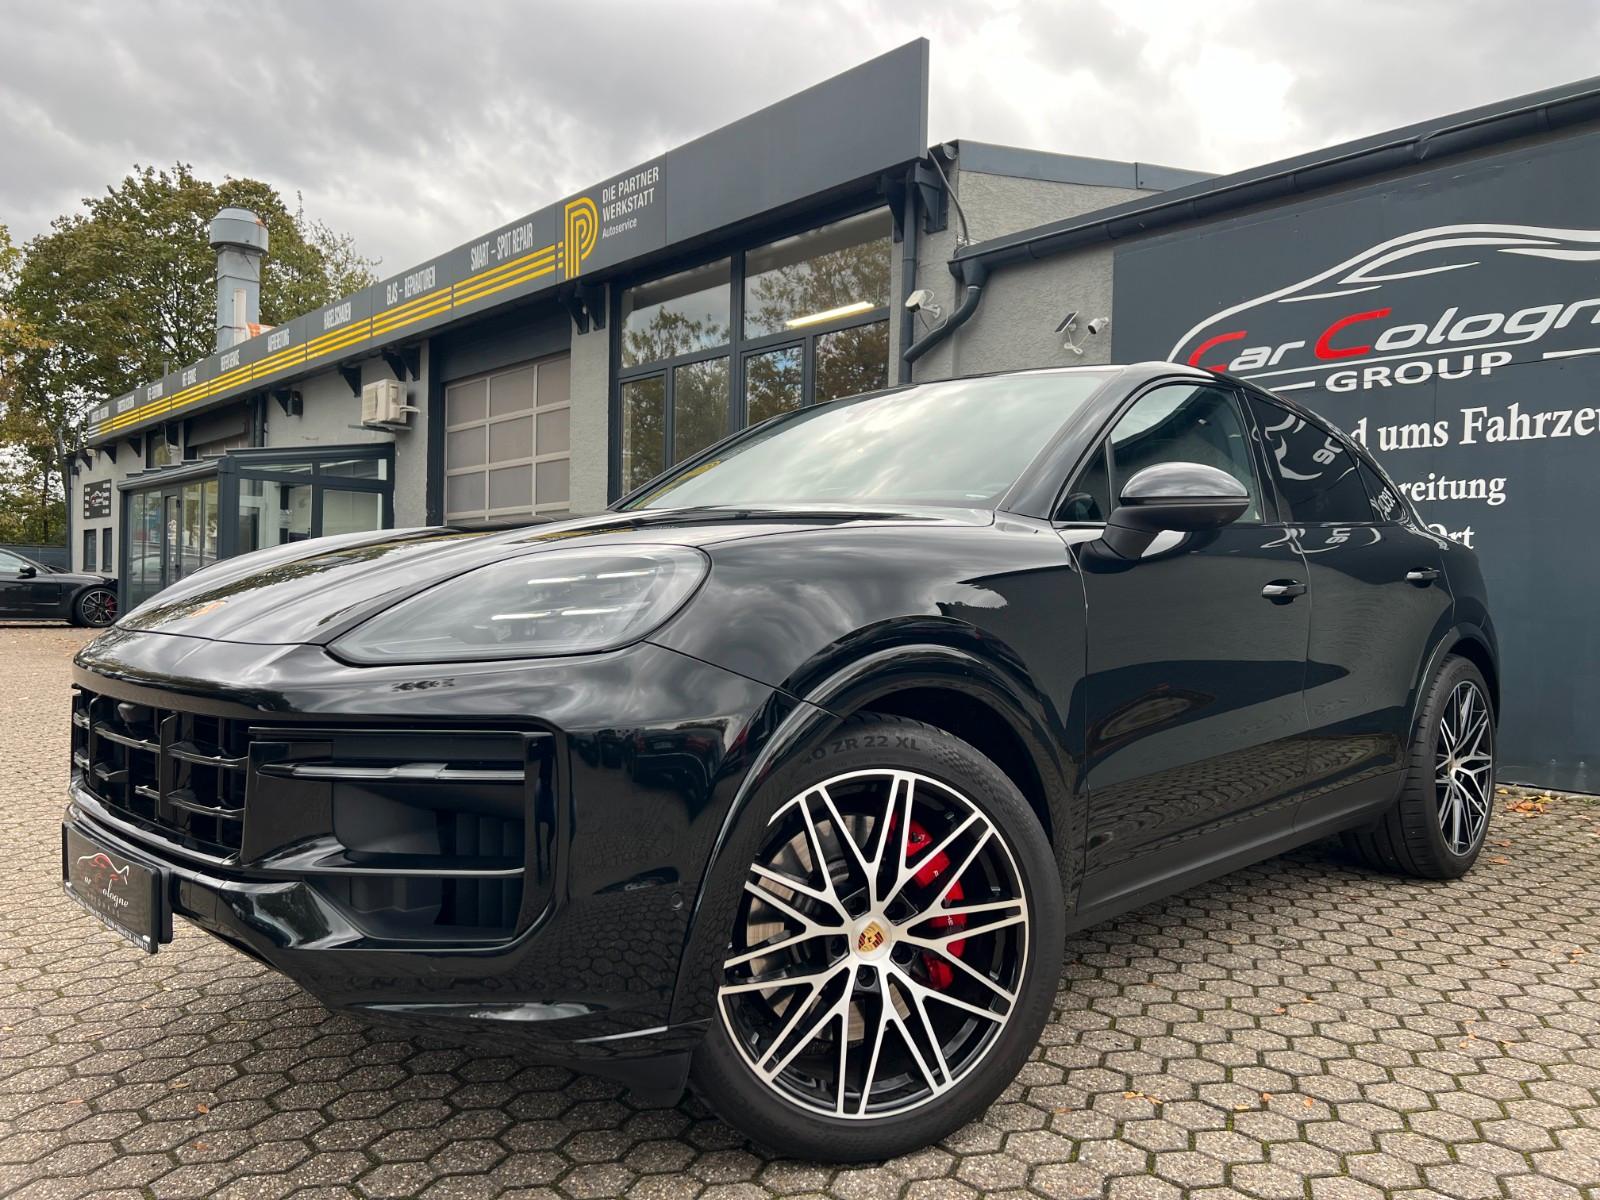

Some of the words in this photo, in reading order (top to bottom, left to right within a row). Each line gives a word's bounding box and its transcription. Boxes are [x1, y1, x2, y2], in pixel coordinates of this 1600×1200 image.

[602, 184, 616, 204] DIE
[618, 166, 659, 197] PARTNER
[602, 187, 655, 223] WERKSTATT
[470, 241, 490, 272] SMART
[497, 231, 512, 260] SPOT
[512, 222, 533, 254] REPAIR
[602, 218, 637, 239] Autoservice
[1188, 330, 1306, 374] Car
[1325, 351, 1512, 393] GROUP
[1377, 420, 1449, 451] ums
[1459, 402, 1600, 445] Fahrze
[832, 738, 858, 754] ZR
[864, 736, 888, 748] 22
[895, 736, 920, 751] XL
